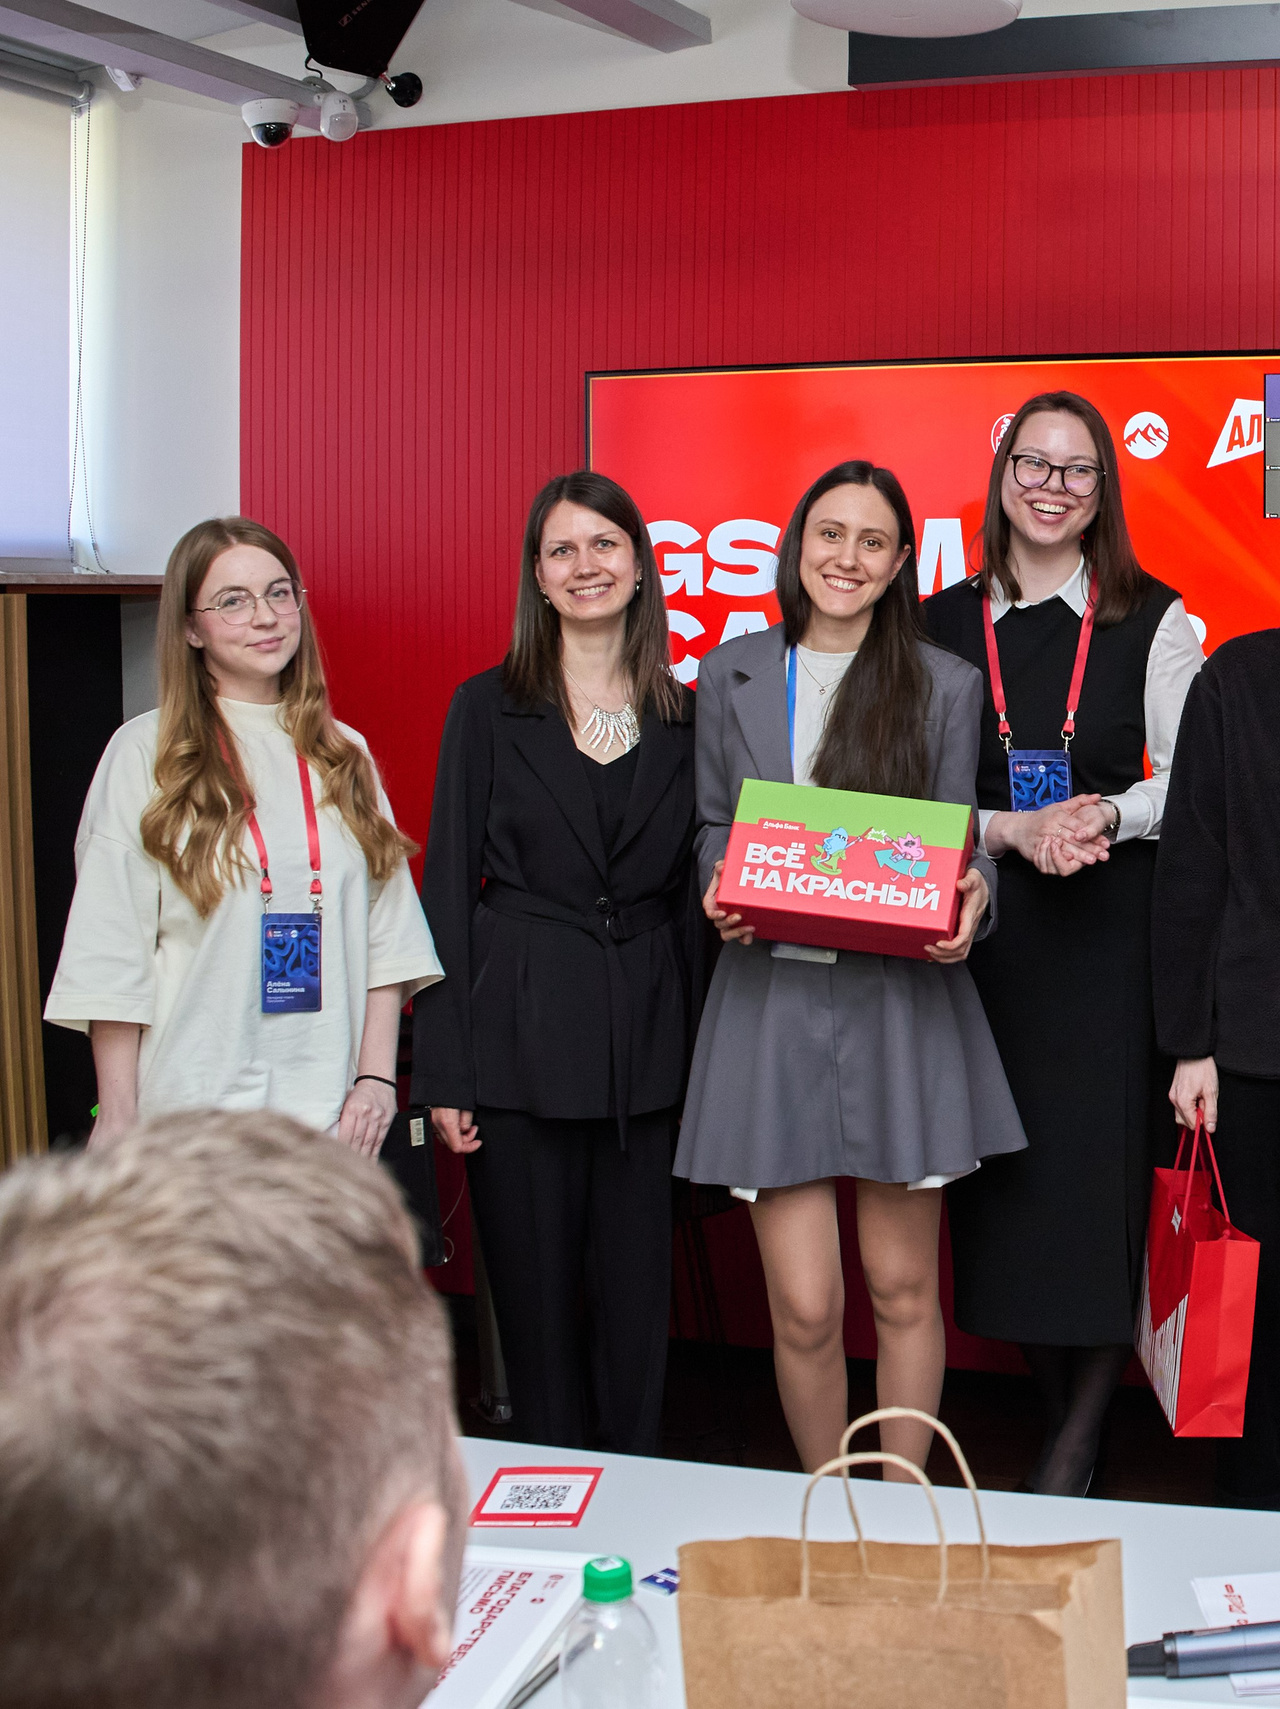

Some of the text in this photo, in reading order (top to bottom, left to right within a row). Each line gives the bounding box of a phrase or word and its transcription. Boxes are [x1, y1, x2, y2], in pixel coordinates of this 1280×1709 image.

[744, 842, 806, 869] ВСЁ
[739, 866, 941, 911] НА КРАСНЫЙ
[469, 1570, 515, 1615] ПИСЬМО
